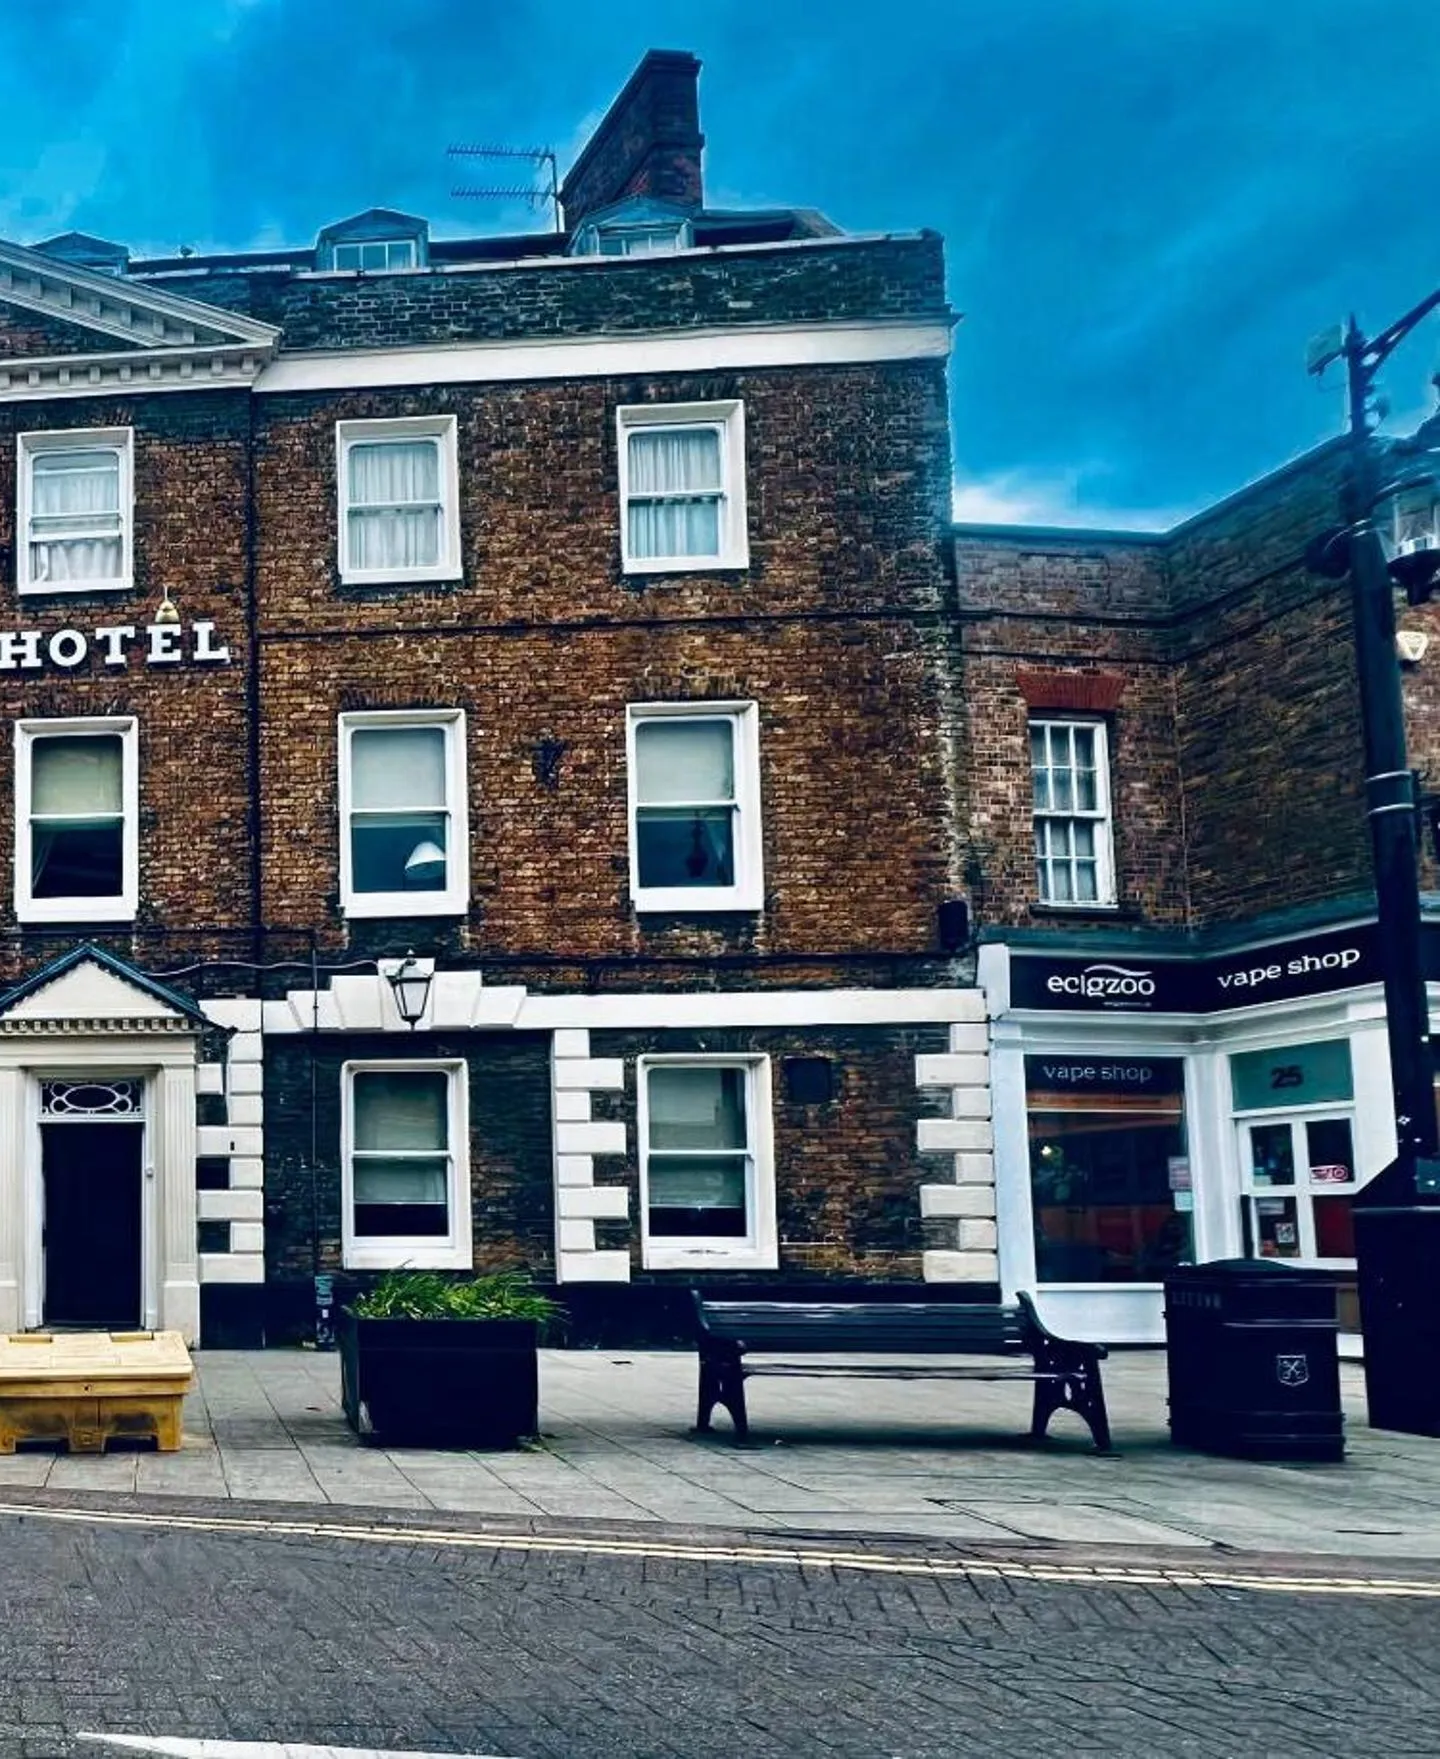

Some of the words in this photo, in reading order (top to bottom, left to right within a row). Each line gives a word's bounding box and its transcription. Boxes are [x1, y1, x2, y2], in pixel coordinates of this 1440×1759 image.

[1216, 964, 1282, 989] vape
[1287, 948, 1361, 975] shop
[1042, 1065, 1096, 1082] vape
[1100, 1064, 1153, 1084] shop
[1270, 1065, 1303, 1090] 25
